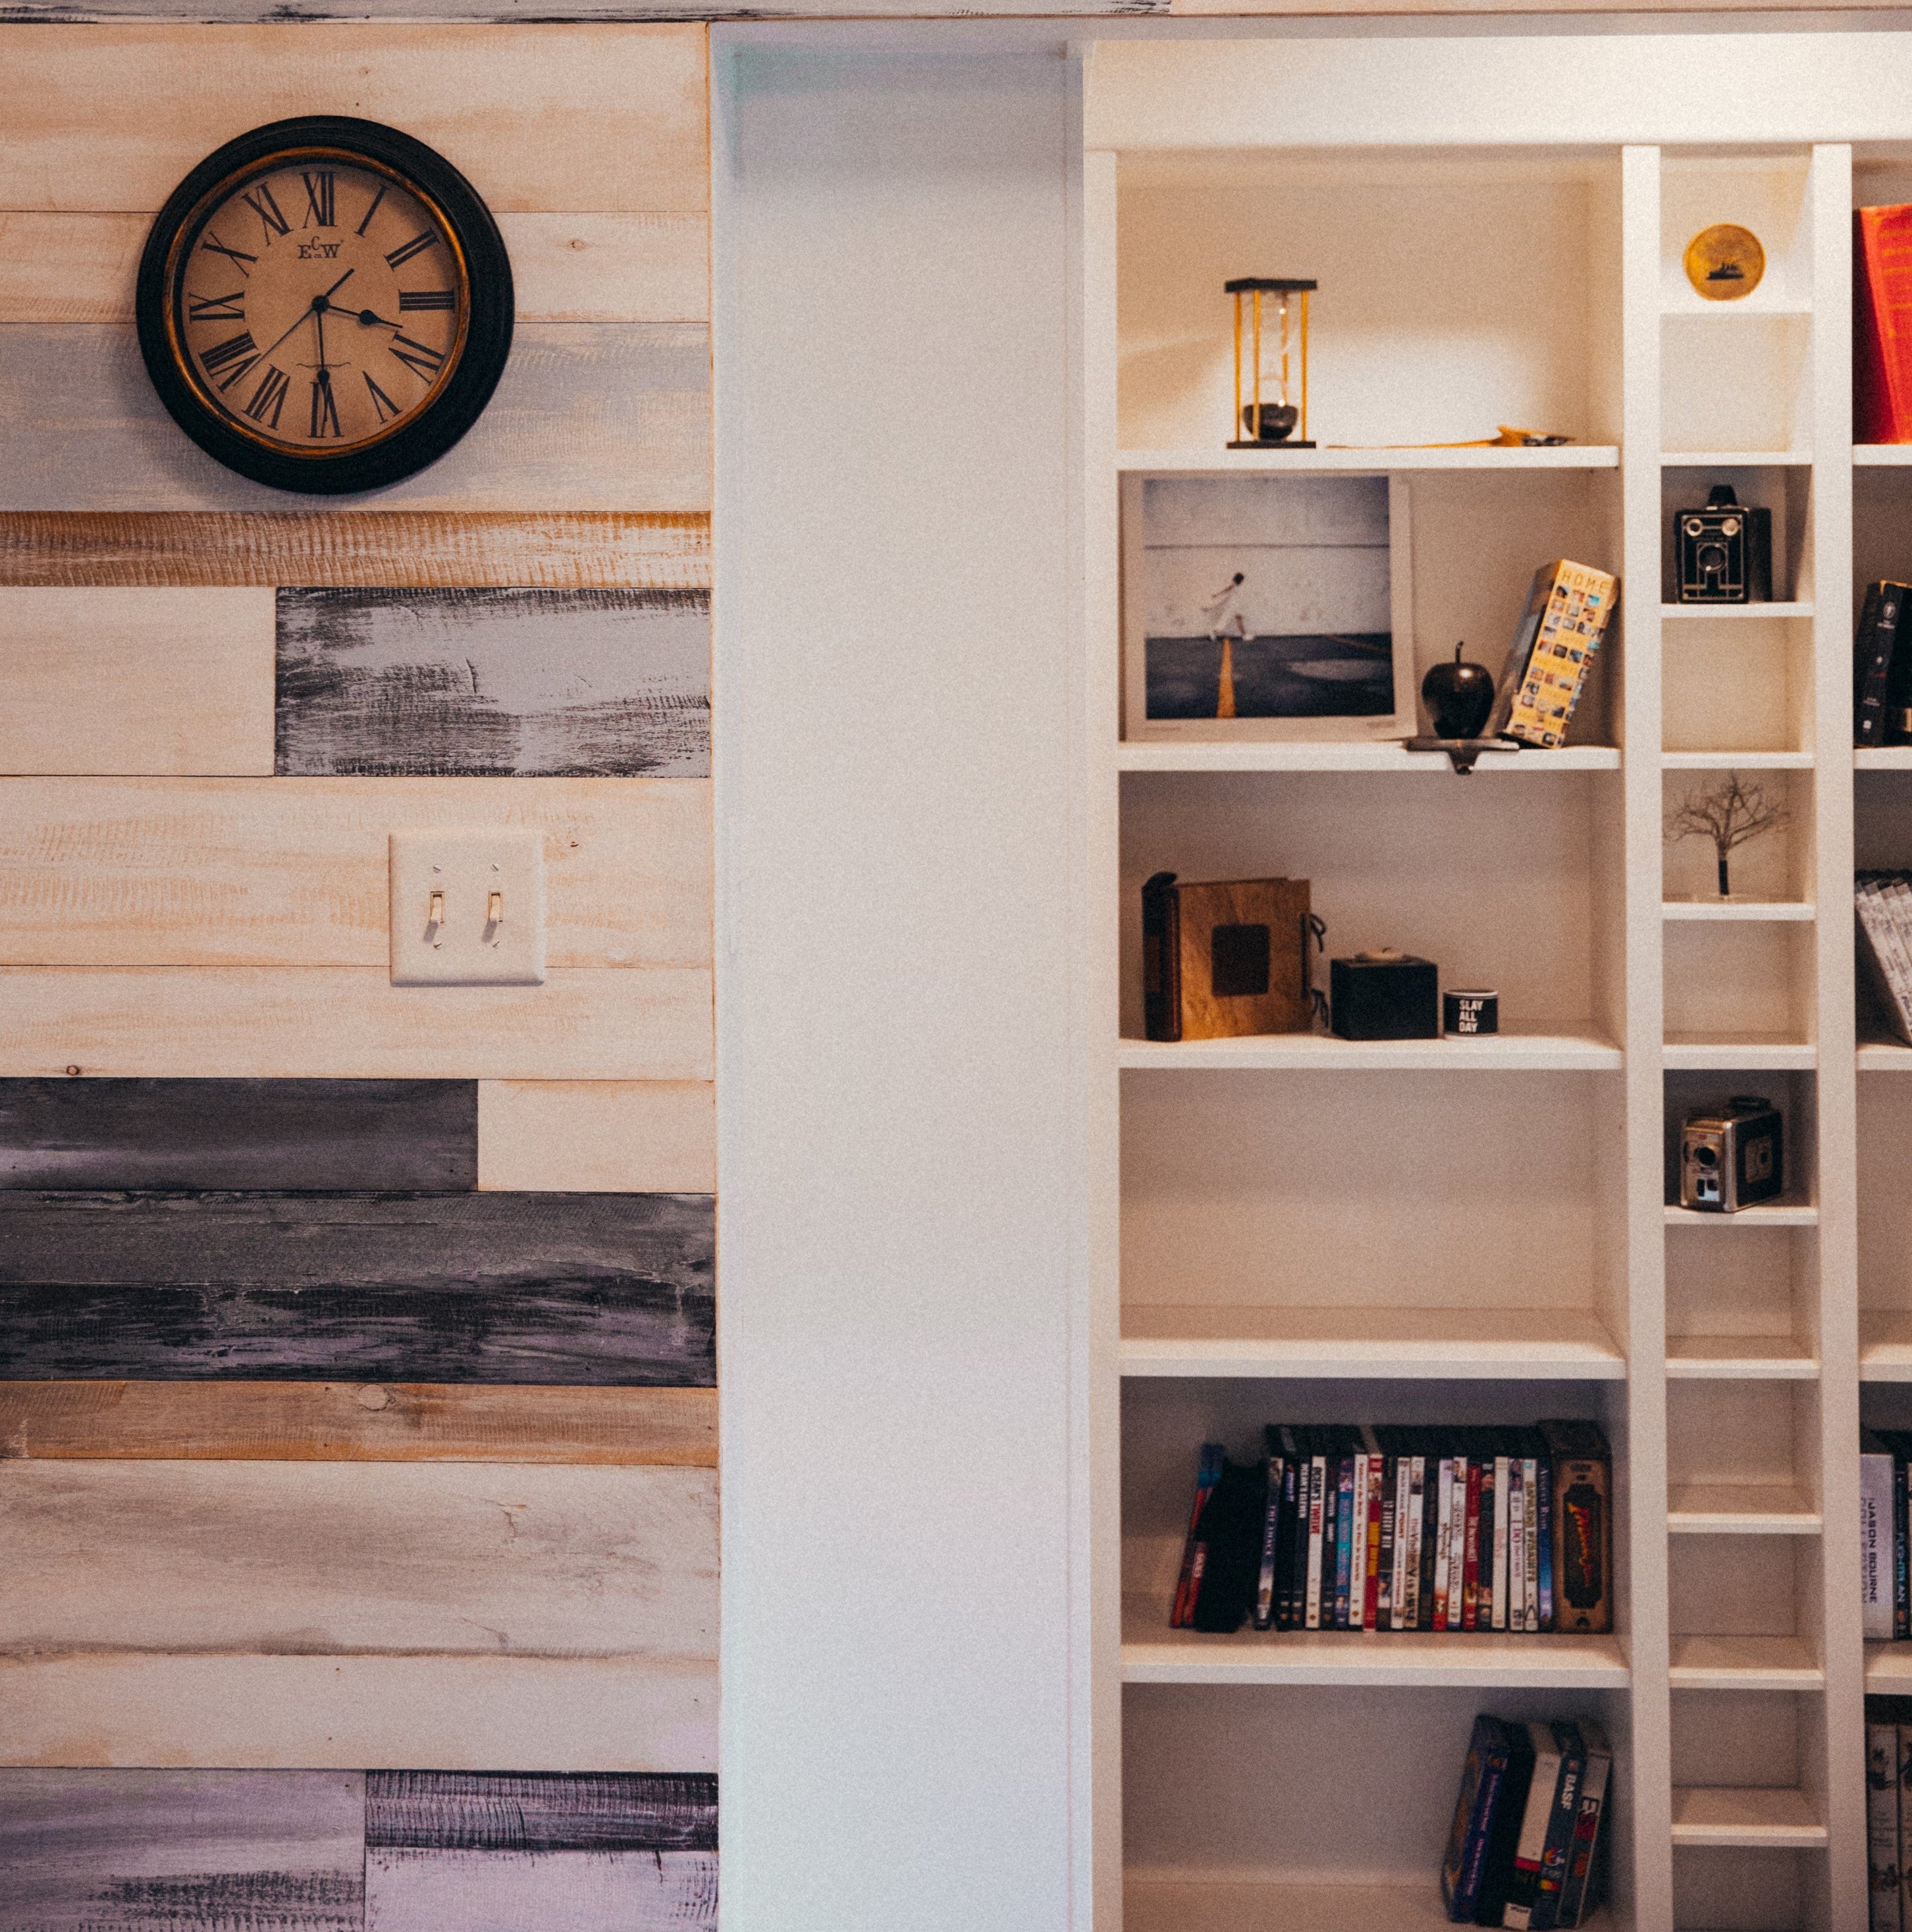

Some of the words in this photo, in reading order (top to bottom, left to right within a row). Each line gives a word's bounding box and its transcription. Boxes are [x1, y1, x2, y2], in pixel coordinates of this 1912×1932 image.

[242, 182, 294, 246] XI
[301, 171, 338, 229] XII
[1458, 1010, 1477, 1022] ALL
[1459, 999, 1484, 1011] SLAY
[1458, 1022, 1479, 1033] DAY
[1310, 1466, 1323, 1501] OCEAN'S
[1310, 1503, 1322, 1535] TWELVE
[1868, 1501, 1877, 1548] JASON
[1869, 1551, 1878, 1604] BOURNE
[1560, 1773, 1578, 1810] BASF
